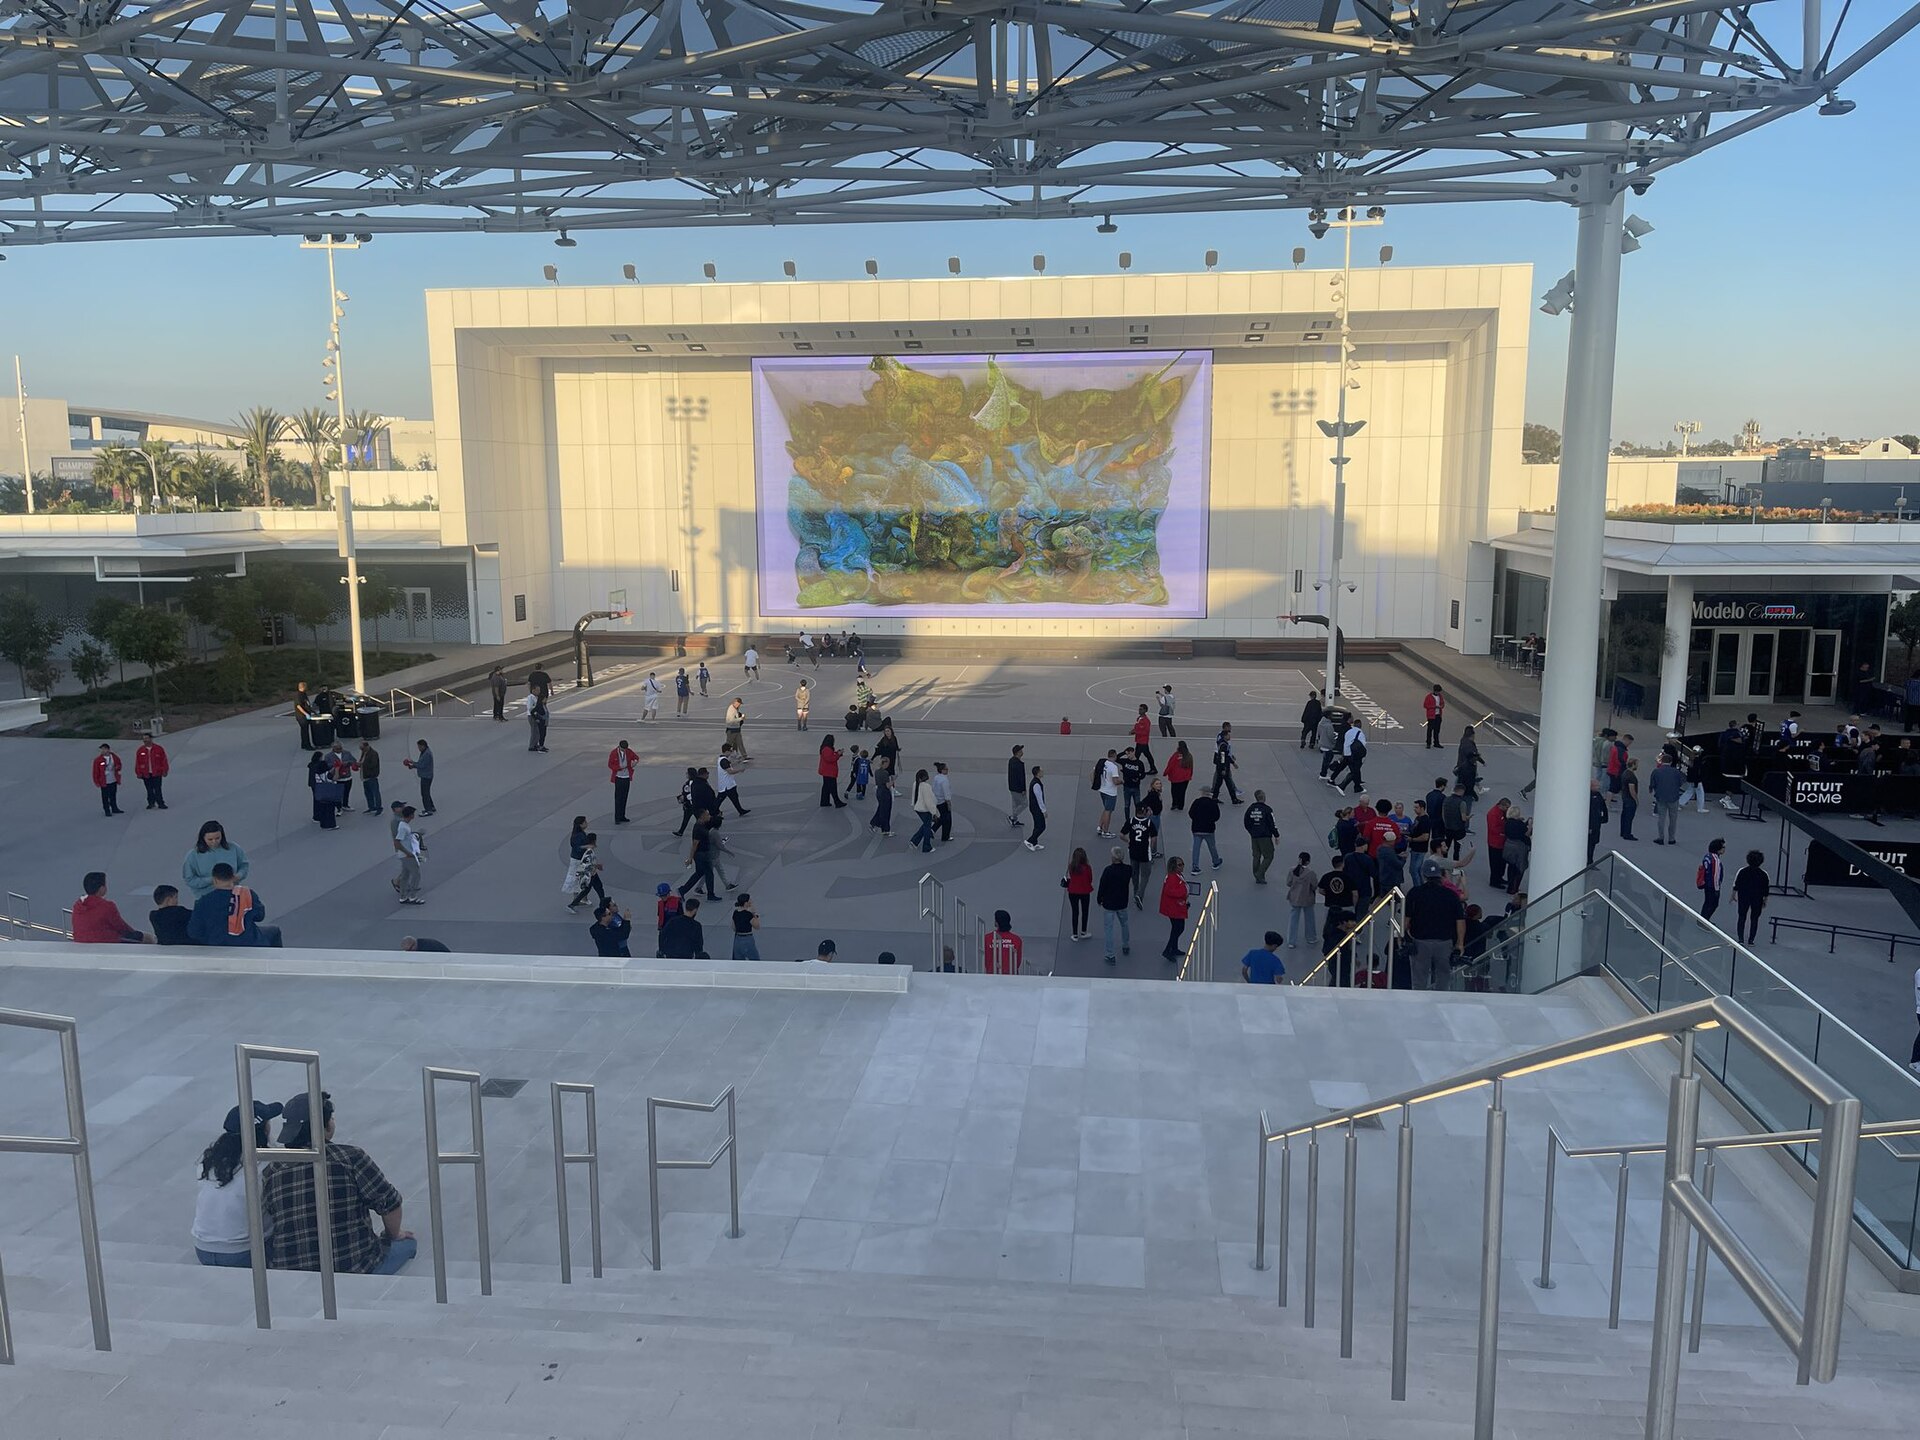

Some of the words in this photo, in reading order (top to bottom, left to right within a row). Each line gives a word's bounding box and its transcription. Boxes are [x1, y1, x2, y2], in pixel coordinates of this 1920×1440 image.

[1692, 601, 1745, 619] Modelo
[1797, 782, 1843, 792] INTUIT
[1796, 793, 1842, 804] DOME
[1135, 829, 1142, 842] 2
[1869, 851, 1908, 864] TUIT
